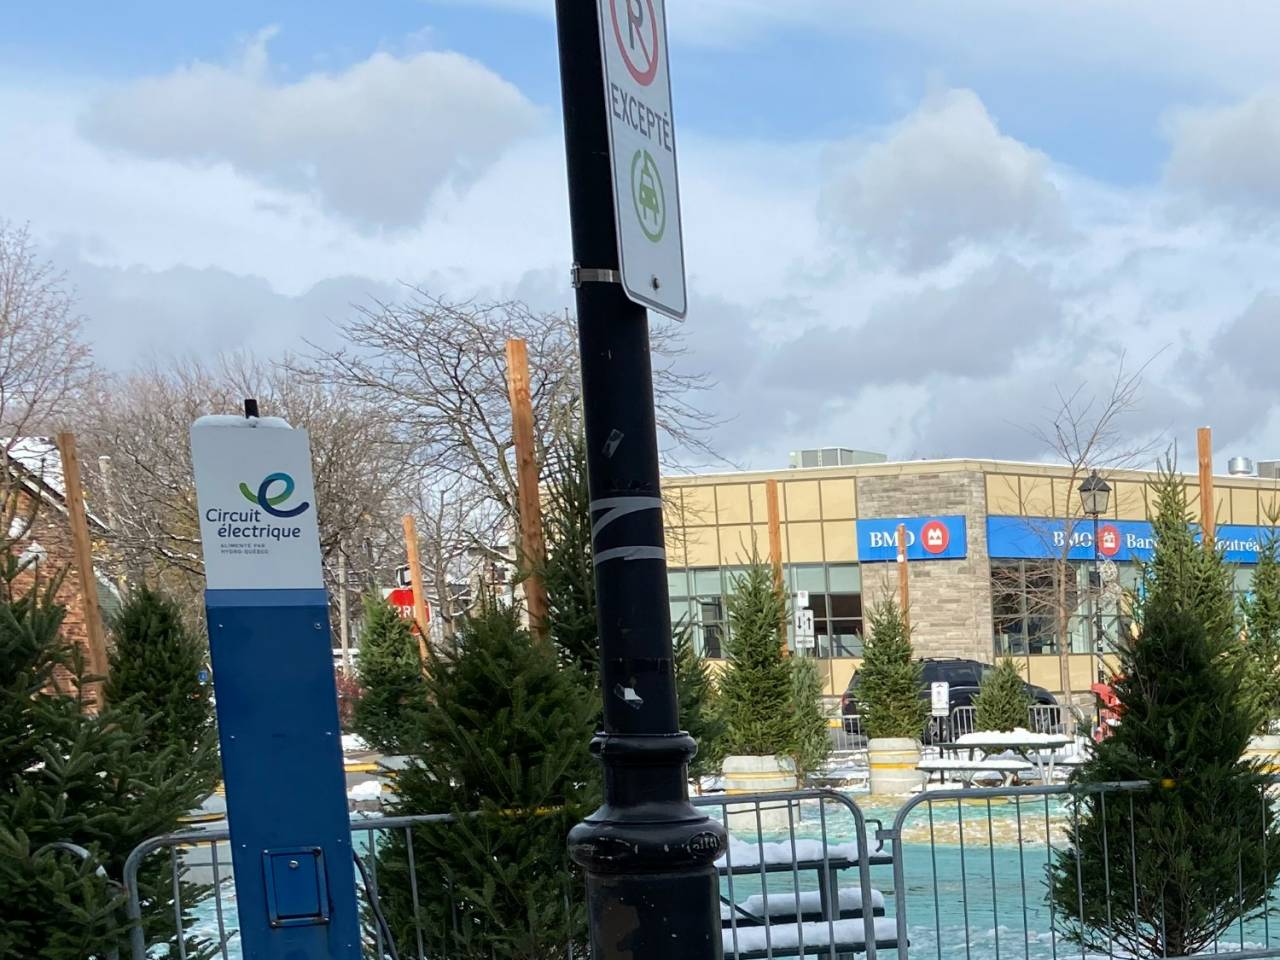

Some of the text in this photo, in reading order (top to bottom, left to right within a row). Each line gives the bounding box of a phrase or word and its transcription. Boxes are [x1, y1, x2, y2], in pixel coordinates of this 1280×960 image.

[611, 82, 672, 152] EXCEPTÉ
[205, 508, 261, 523] Circuit
[217, 524, 301, 541] électrique
[869, 530, 915, 548] BMO
[1053, 531, 1092, 548] BMO
